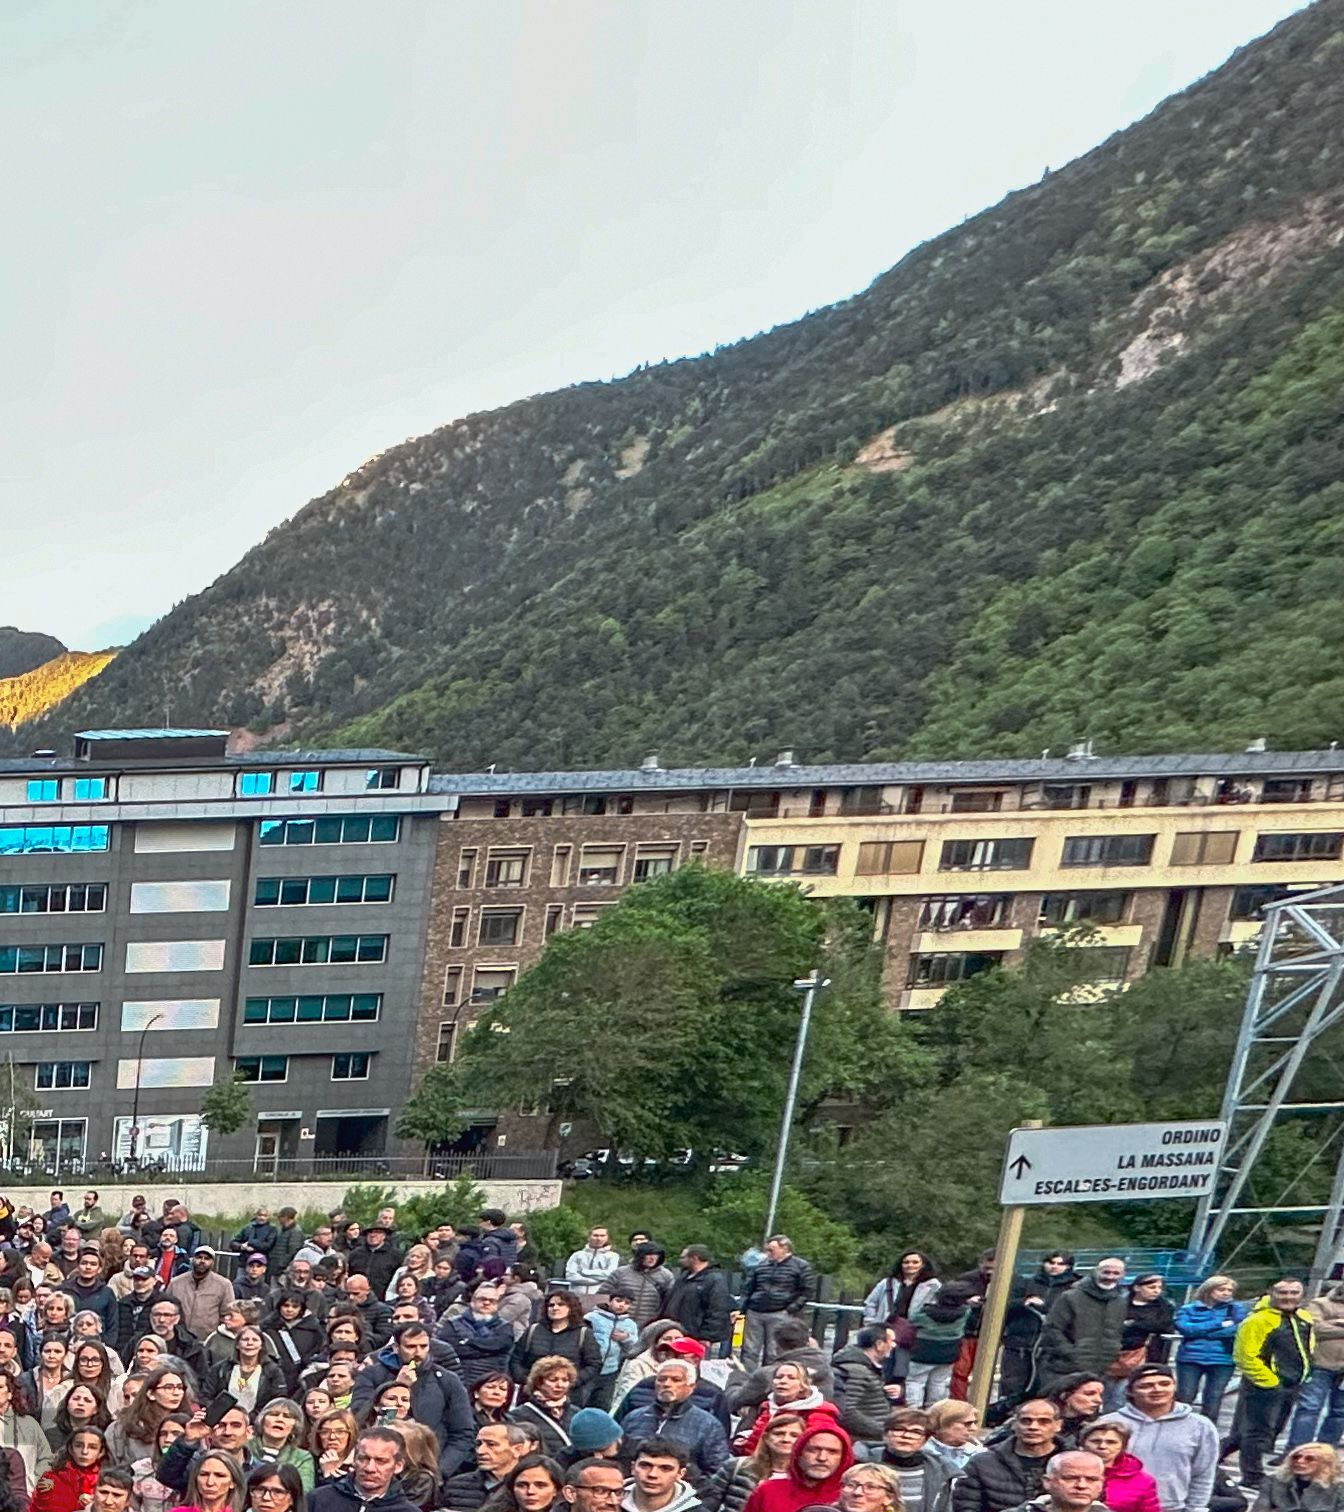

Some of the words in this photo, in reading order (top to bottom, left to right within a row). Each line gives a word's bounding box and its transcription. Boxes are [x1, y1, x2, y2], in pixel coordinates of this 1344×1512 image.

[1162, 1129, 1221, 1145] ORDINO
[1118, 1155, 1136, 1170] LA
[1140, 1151, 1214, 1168] MASSANA
